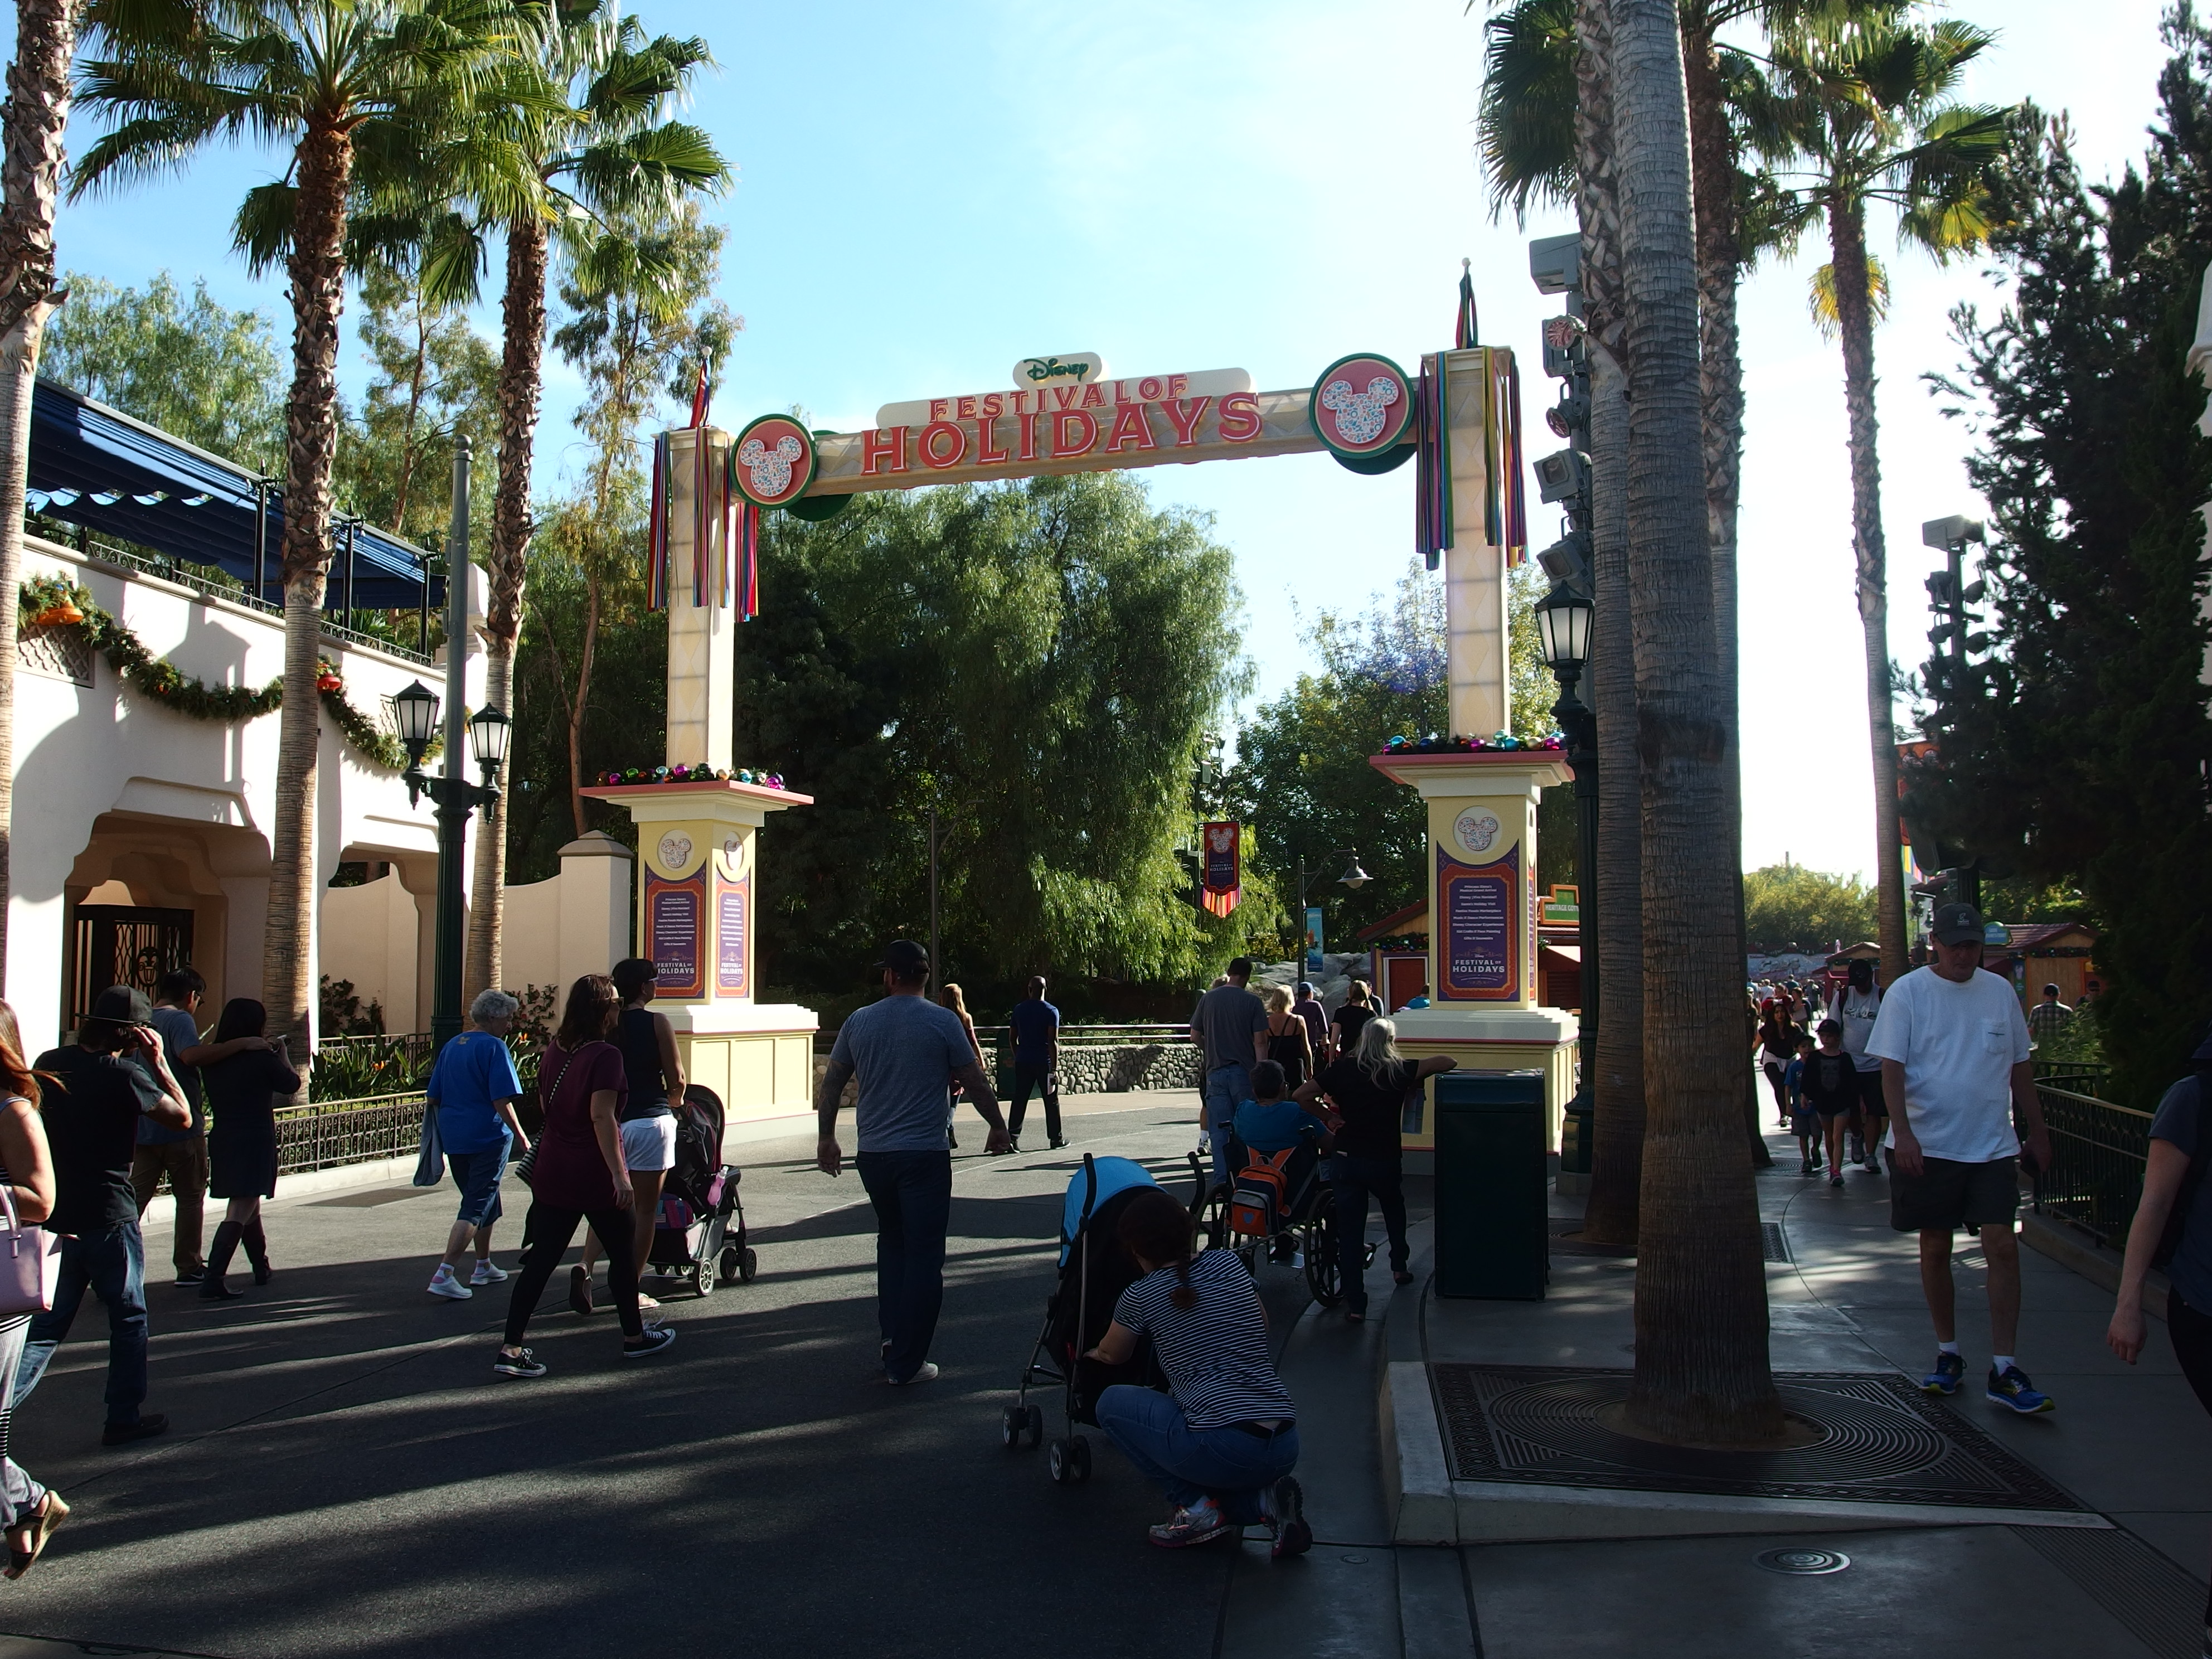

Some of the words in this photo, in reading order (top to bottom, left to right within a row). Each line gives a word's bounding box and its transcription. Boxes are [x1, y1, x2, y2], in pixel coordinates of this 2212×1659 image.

[929, 379, 1132, 423] FESTIVAL
[1138, 373, 1189, 400] OF
[860, 392, 1262, 476] HOLIDAYS
